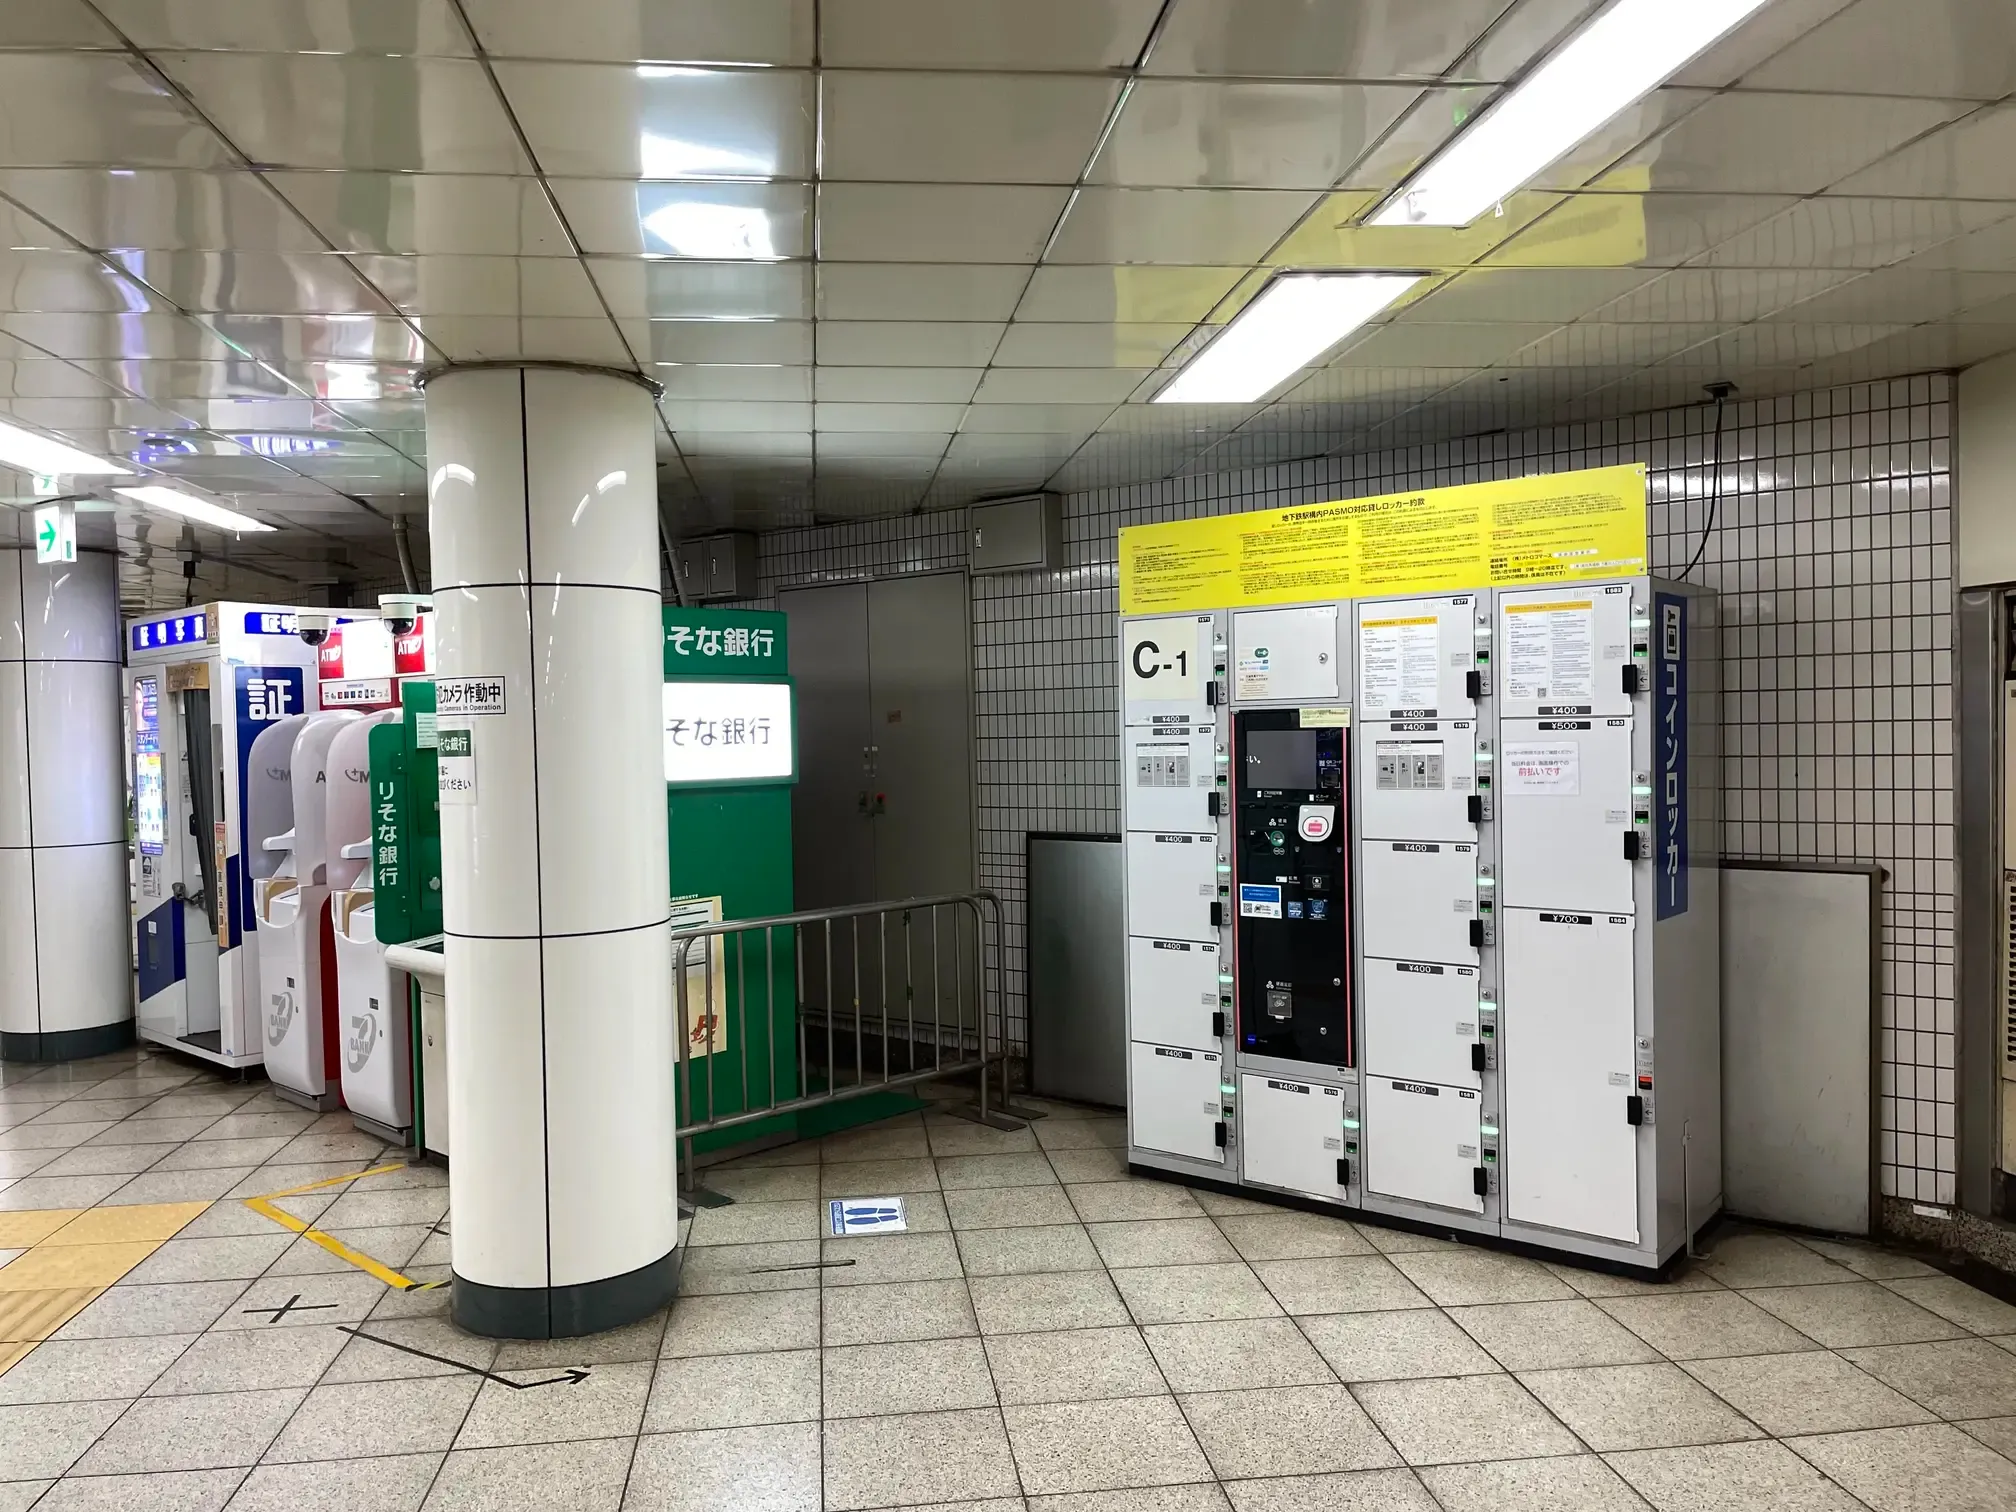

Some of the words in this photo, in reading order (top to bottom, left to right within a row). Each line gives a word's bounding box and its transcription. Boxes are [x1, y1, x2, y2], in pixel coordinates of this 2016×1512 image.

[661, 625, 774, 657] そな銀行
[1133, 640, 1187, 679] C-1
[247, 678, 293, 721] 証
[469, 703, 502, 712] Operation
[1552, 706, 1578, 714] ¥400
[1402, 710, 1425, 718] ¥400
[1402, 723, 1425, 731] ¥400
[1552, 722, 1578, 730] ¥500
[1518, 767, 1561, 777] 前払いです
[1665, 664, 1679, 907] コインロッカー
[377, 781, 399, 887] りそな銀行
[1404, 844, 1427, 852] ¥400
[1552, 914, 1579, 924] ¥700
[1163, 942, 1181, 950] ¥400
[1409, 964, 1431, 973] ¥400
[270, 1015, 289, 1030] BANK
[350, 1036, 370, 1054] BANK
[1165, 1049, 1183, 1058] ¥400
[1278, 1082, 1299, 1092] ¥400
[1404, 1084, 1427, 1094] ¥400
